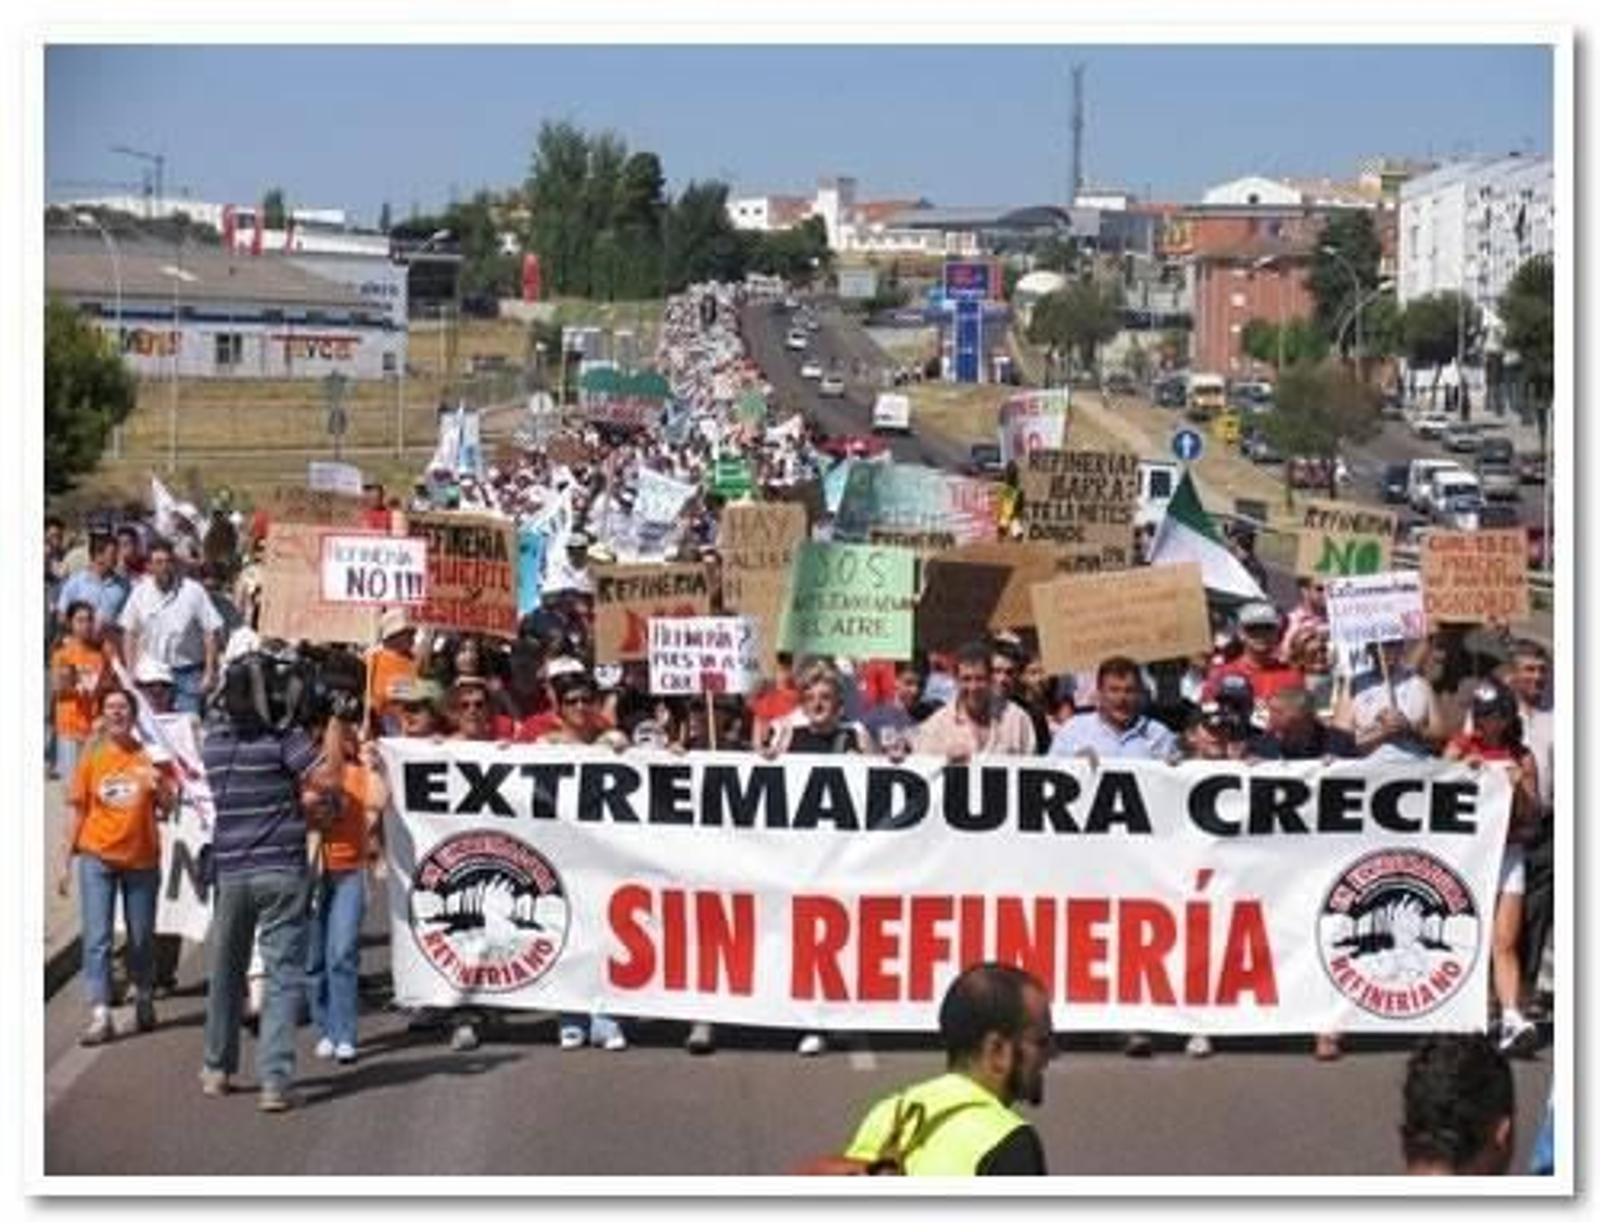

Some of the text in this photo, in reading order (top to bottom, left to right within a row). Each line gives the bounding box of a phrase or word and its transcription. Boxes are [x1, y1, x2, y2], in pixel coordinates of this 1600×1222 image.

[1316, 535, 1381, 575] NO
[402, 759, 1480, 837] EXTREMADURA CRECE
[606, 883, 759, 996] SIN
[790, 867, 1280, 1007] REFINERÍA
